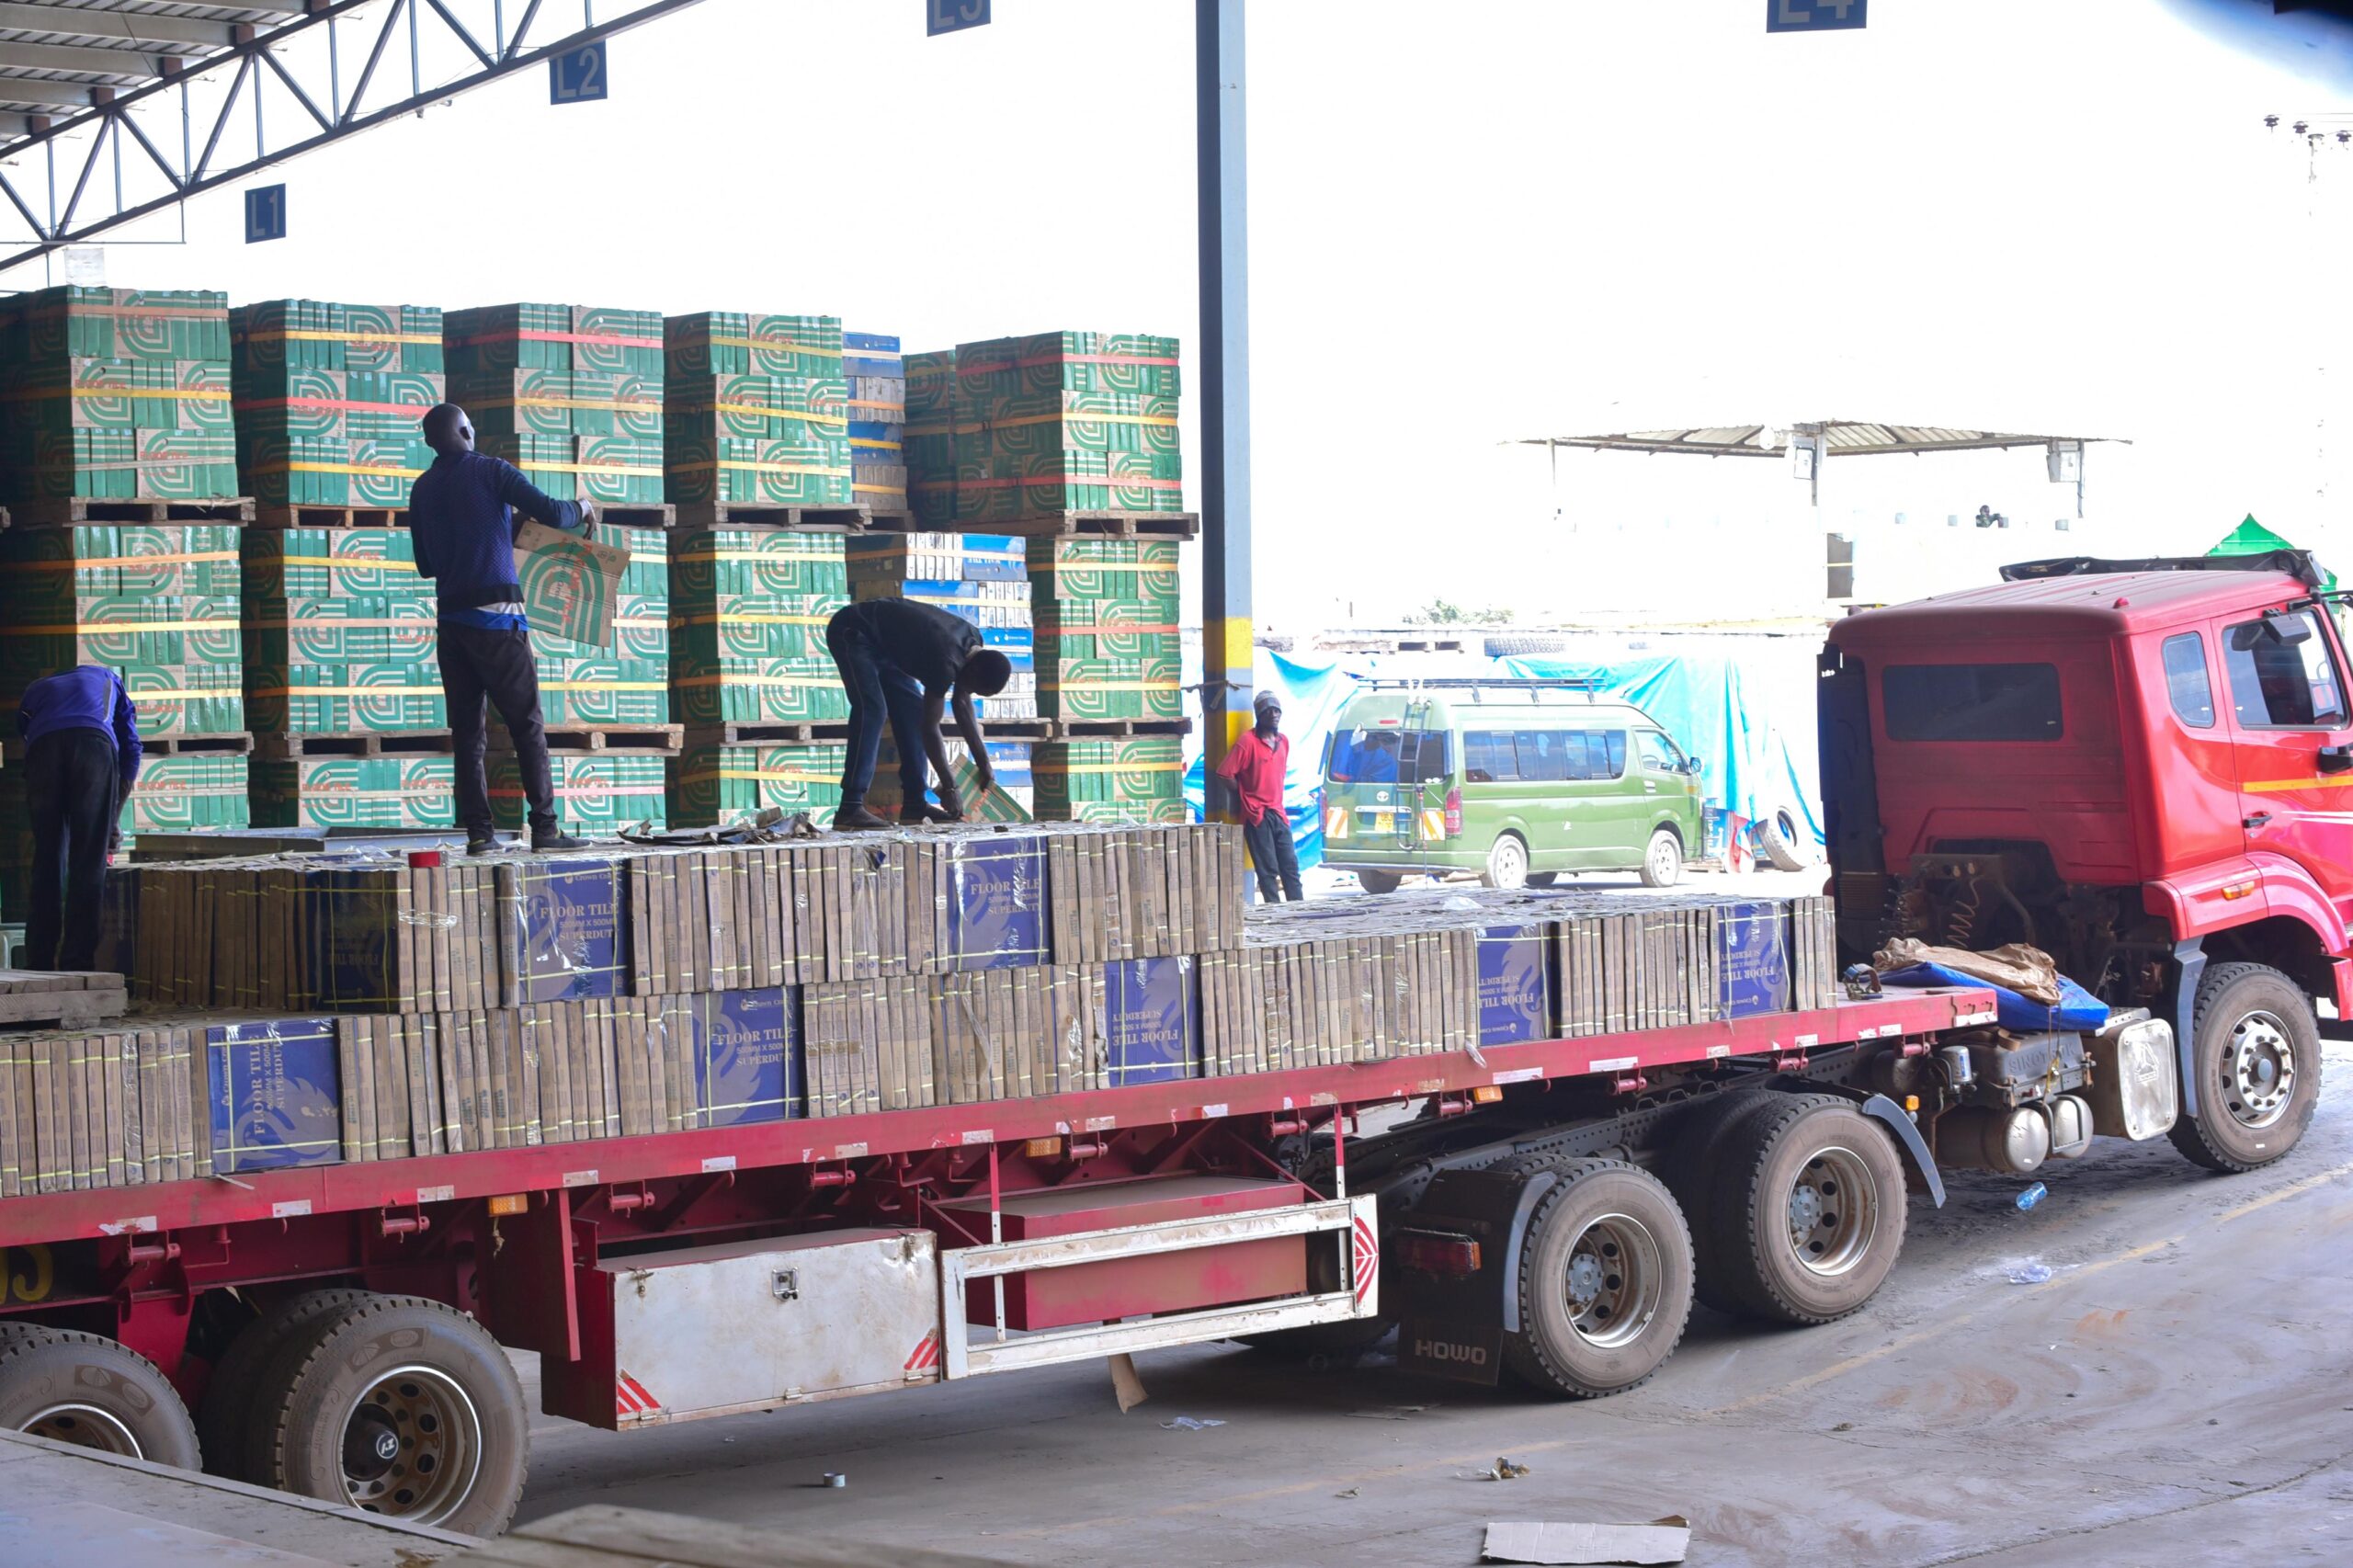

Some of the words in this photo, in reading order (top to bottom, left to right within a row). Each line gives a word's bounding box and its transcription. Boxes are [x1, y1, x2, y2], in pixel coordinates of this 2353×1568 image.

[557, 48, 599, 98] L2
[251, 189, 278, 236] L1
[971, 881, 1011, 895] FLOOR
[1014, 878, 1040, 891] LE
[540, 904, 585, 919] FLOOR
[988, 903, 1040, 915] SUPERDUT
[560, 928, 618, 940] SUPERDUT
[1479, 976, 1519, 986] SUPERDUT
[1721, 971, 1743, 983] TIE
[1501, 993, 1534, 1006] FLOOR
[718, 1030, 761, 1045] FLOOR
[763, 1027, 793, 1040] TILE
[1141, 1028, 1178, 1043] FLOOR
[273, 1036, 285, 1108] SUPERDUT
[251, 1078, 266, 1135] FLOOR
[1415, 1339, 1486, 1365] HOWO
